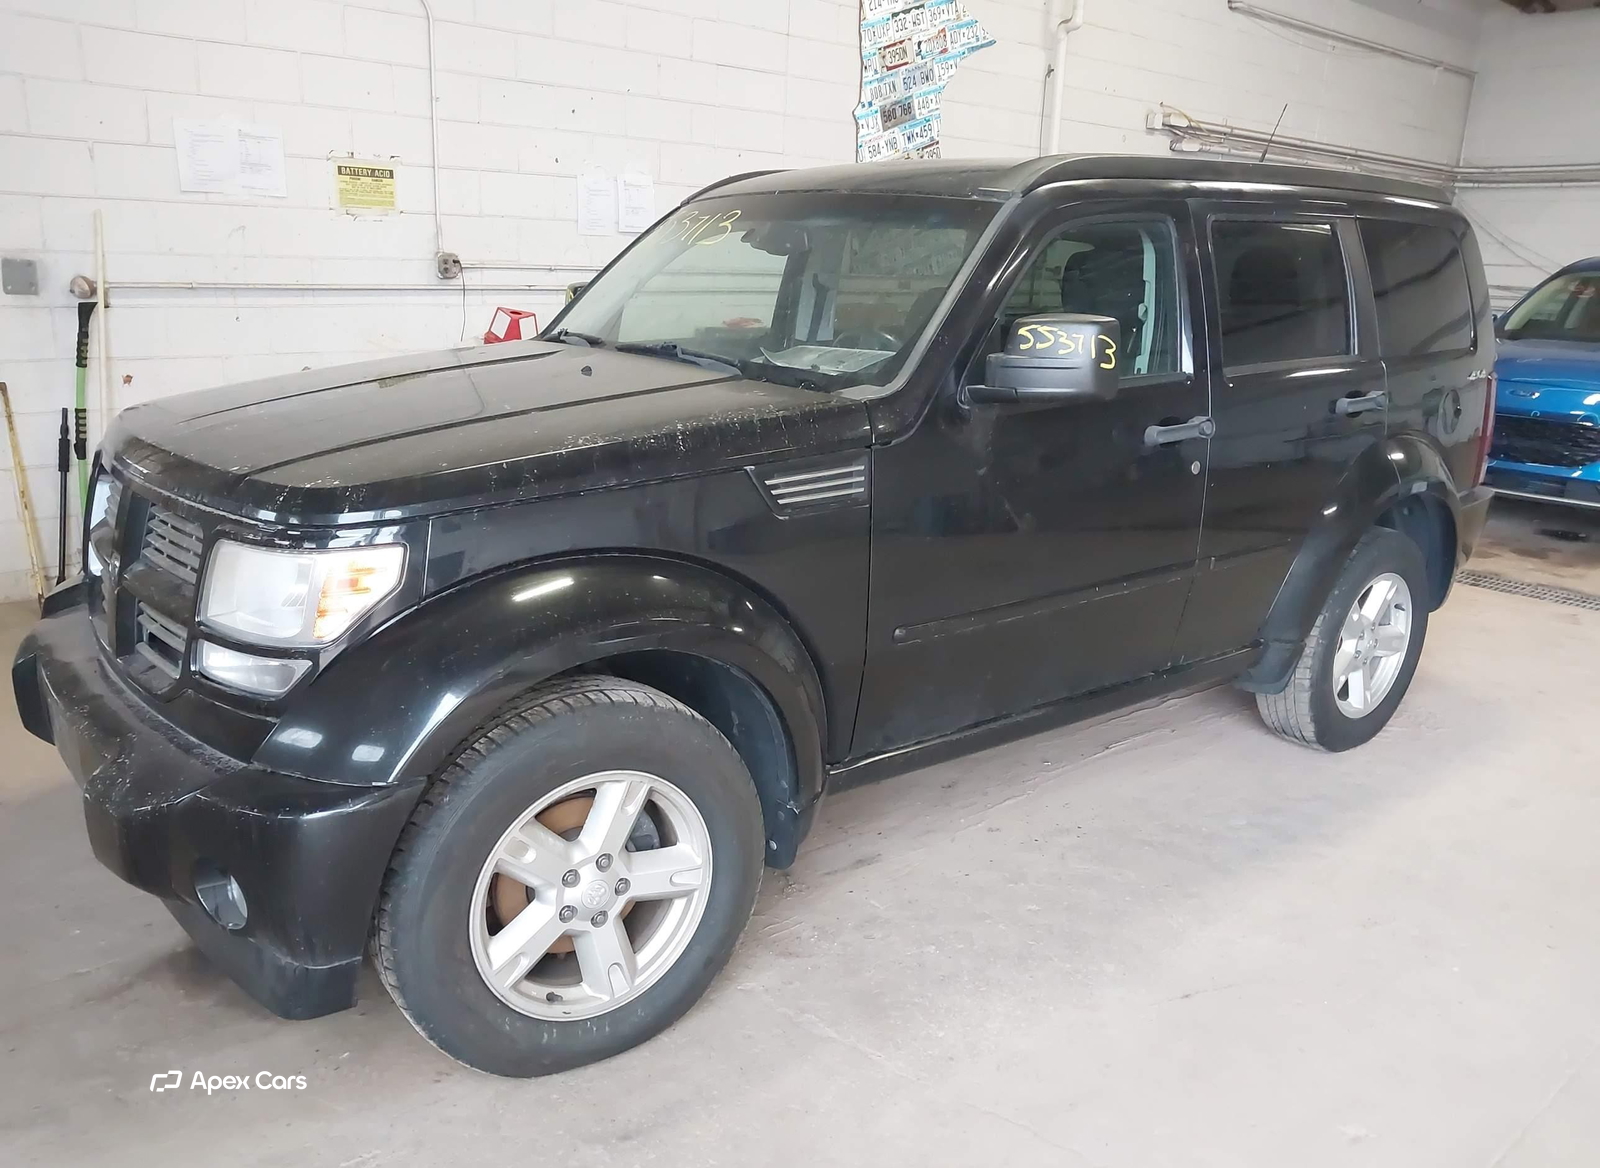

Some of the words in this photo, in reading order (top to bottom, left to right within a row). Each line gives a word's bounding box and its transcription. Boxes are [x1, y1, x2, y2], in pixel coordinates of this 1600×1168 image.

[341, 166, 372, 177] BATTERY
[374, 170, 390, 178] ACID
[1017, 325, 1117, 369] 553713
